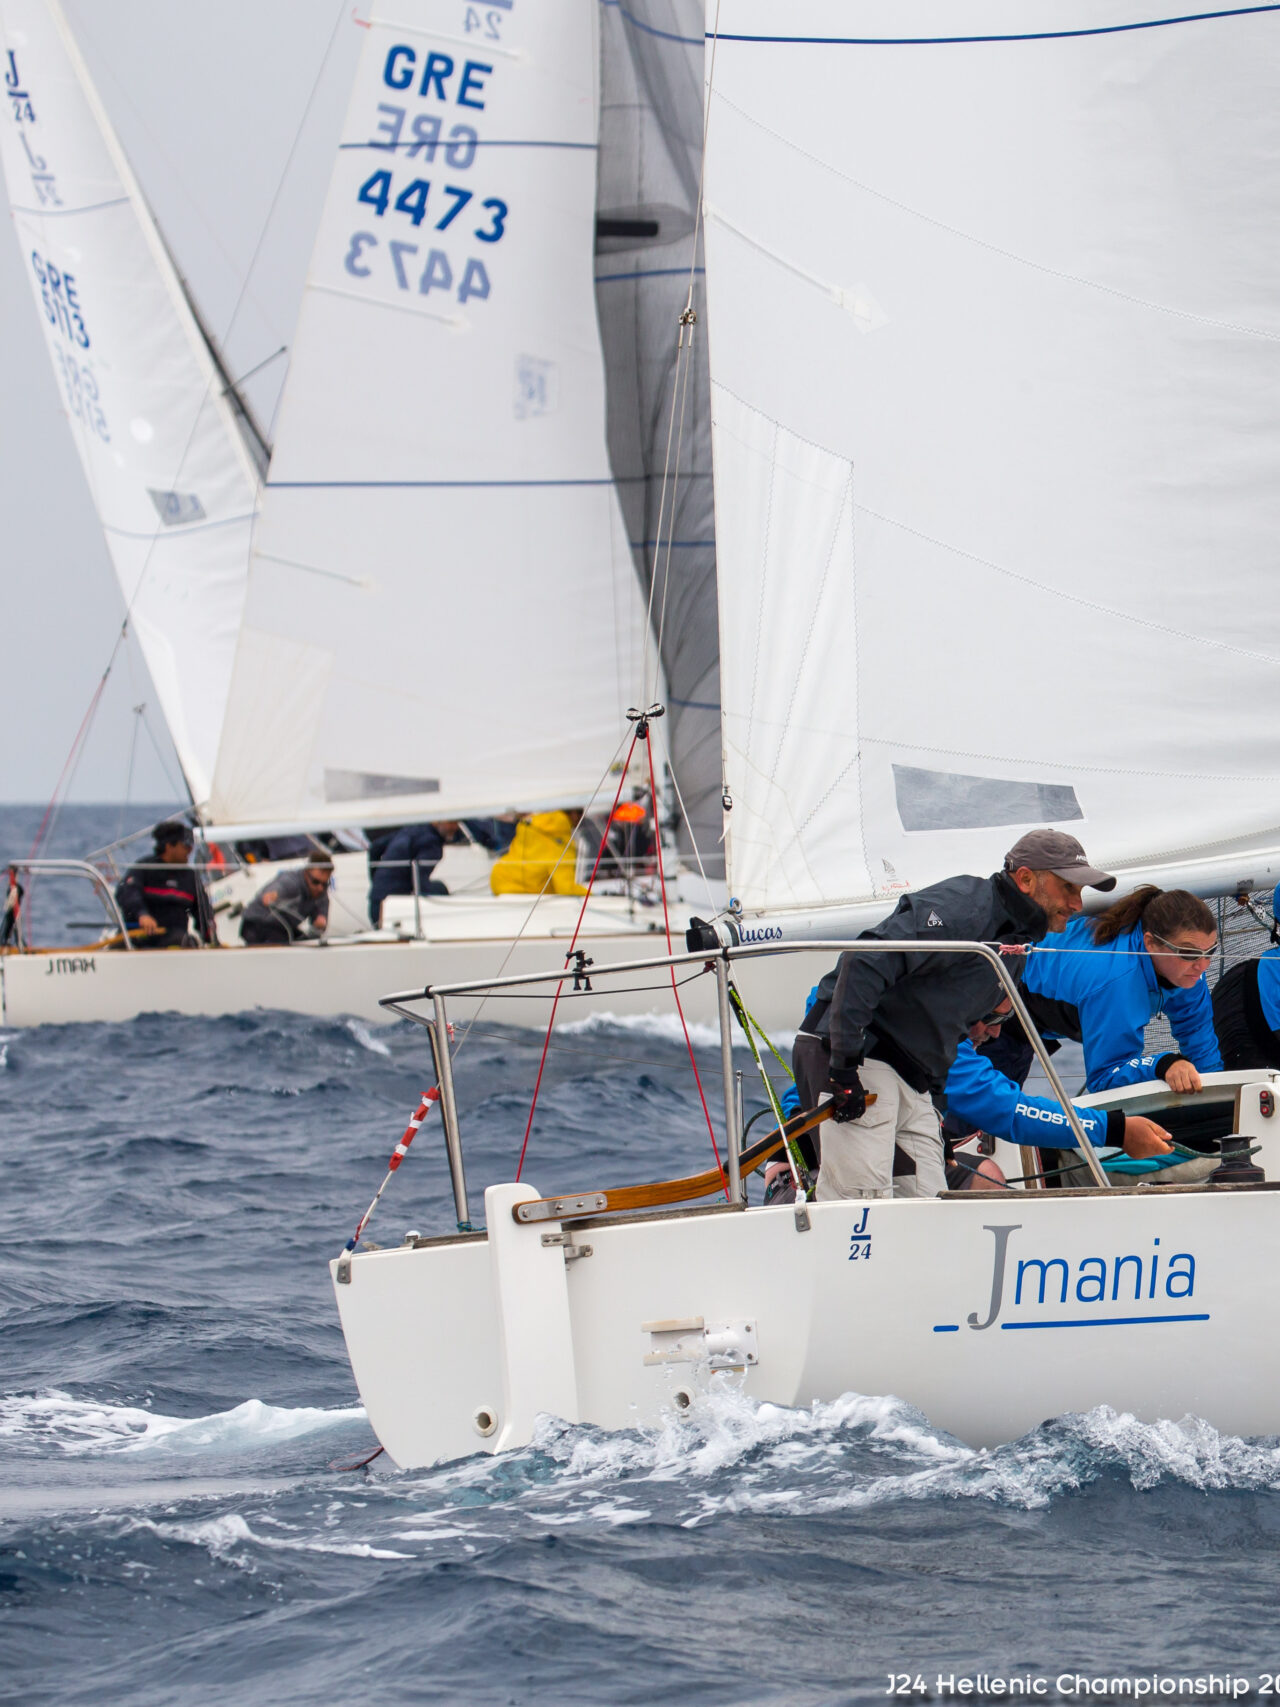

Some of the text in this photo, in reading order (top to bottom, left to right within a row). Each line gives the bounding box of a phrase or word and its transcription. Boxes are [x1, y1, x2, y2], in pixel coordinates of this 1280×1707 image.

[383, 44, 493, 111] GRE
[357, 168, 508, 243] 4473
[32, 249, 80, 310] GRE
[738, 925, 783, 942] lucas
[1015, 1103, 1095, 1131] ROOSTR
[853, 1207, 870, 1234] J
[848, 1243, 872, 1260] 24
